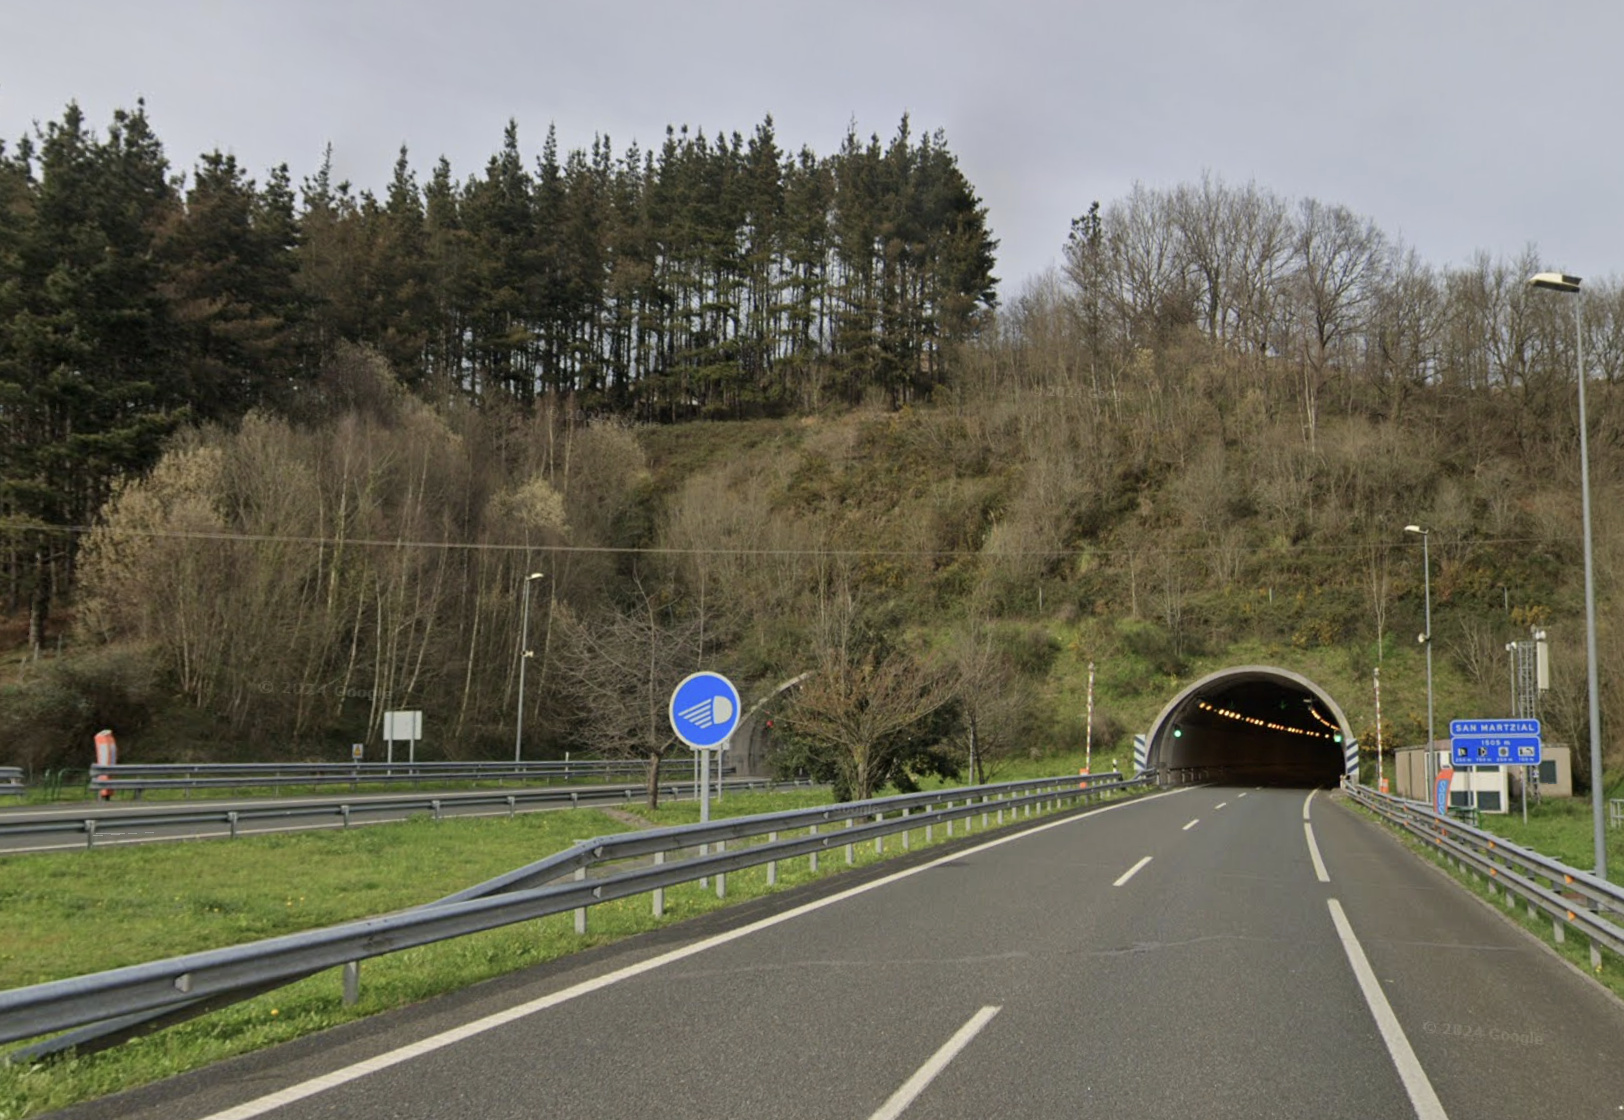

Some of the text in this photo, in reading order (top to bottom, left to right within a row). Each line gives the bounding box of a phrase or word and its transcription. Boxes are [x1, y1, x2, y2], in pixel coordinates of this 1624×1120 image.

[1455, 723, 1535, 732] SAN MARTZIAL
[1438, 780, 1448, 816] SOS
